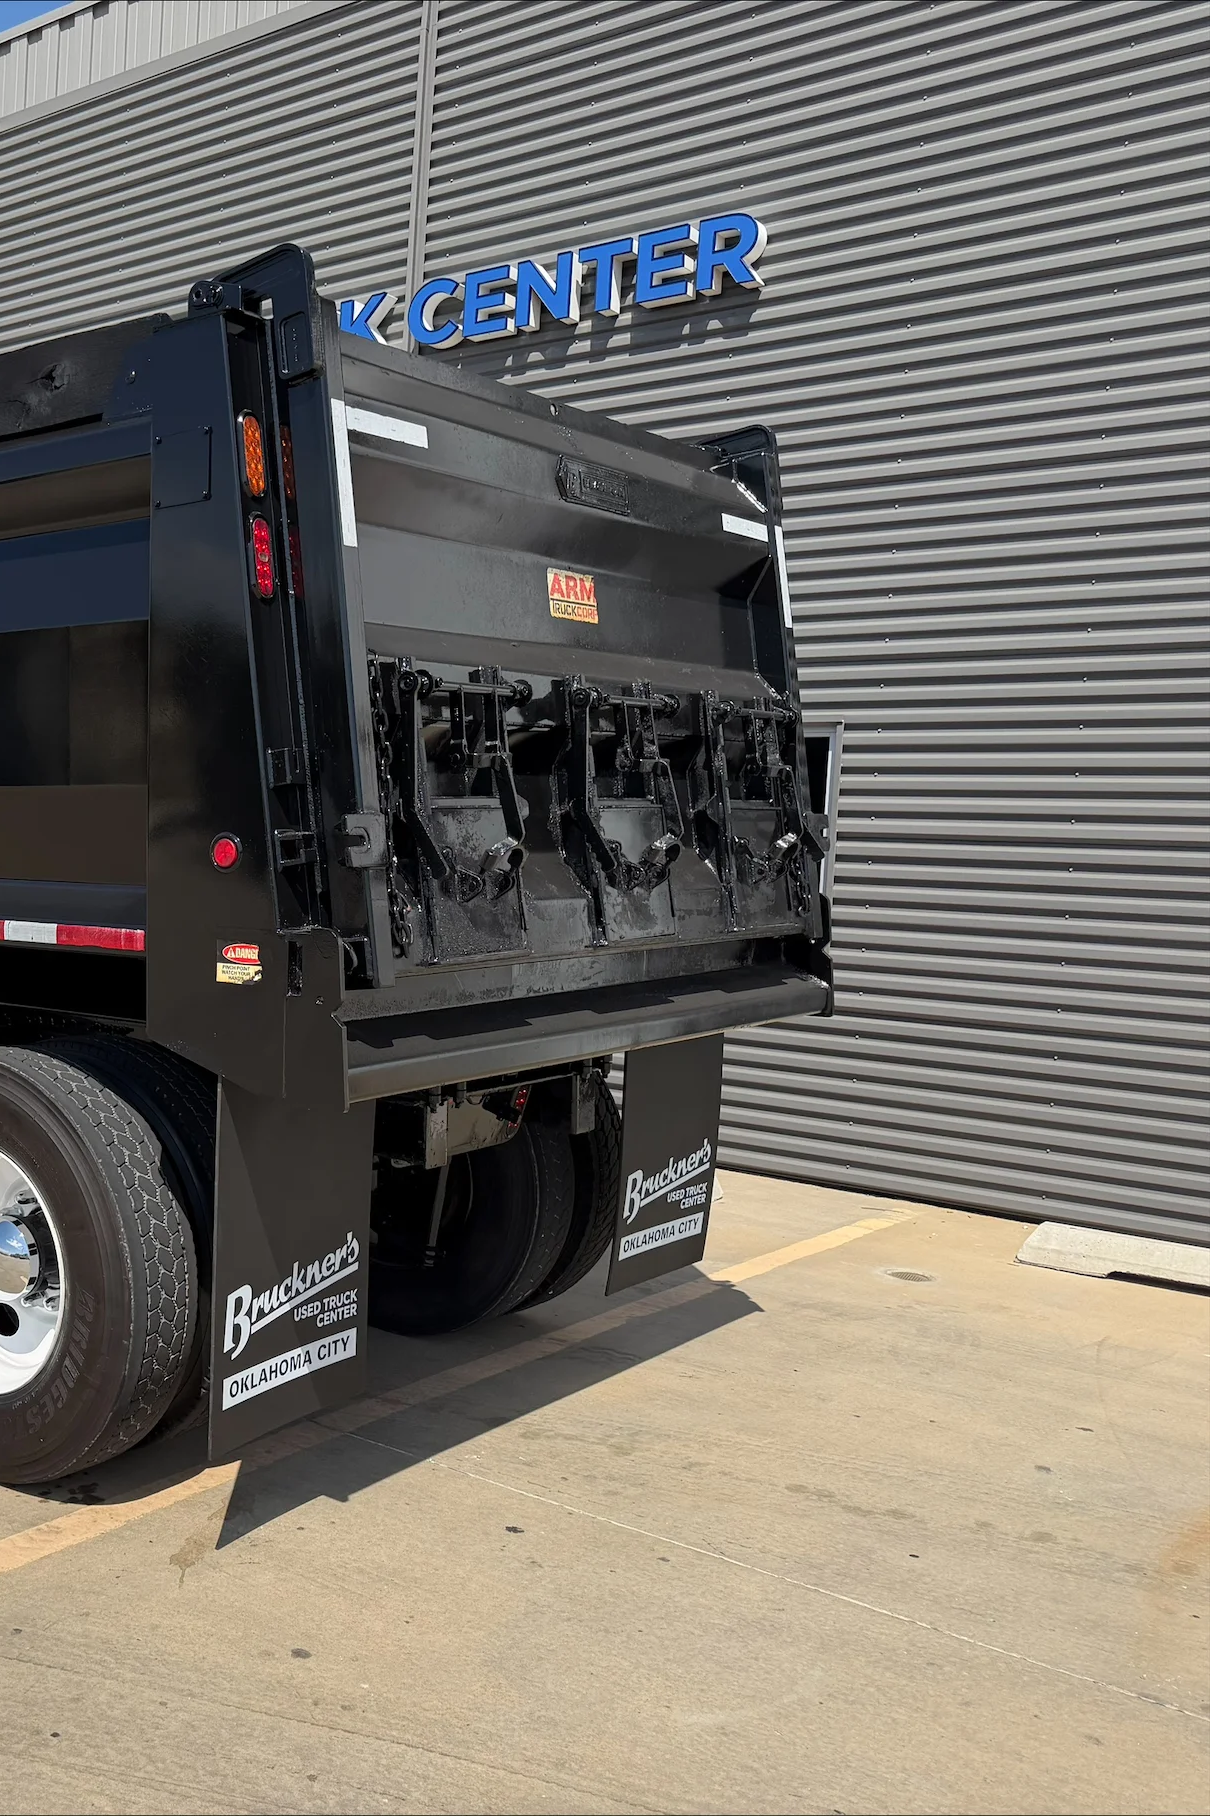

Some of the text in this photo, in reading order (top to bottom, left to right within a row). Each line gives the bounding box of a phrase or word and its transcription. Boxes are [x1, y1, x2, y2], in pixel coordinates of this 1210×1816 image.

[407, 212, 763, 347] CENTER
[550, 573, 596, 604] ARM
[235, 947, 259, 960] DANG
[623, 1137, 712, 1225] Bruckner's
[667, 1182, 708, 1203] USED TRUCK
[680, 1193, 707, 1209] CENTER
[623, 1217, 700, 1253] OKLAHOMA CITY
[223, 1231, 360, 1361] Bruckner's
[293, 1288, 358, 1322] USED TRUCK
[316, 1303, 358, 1328] CENTER
[229, 1335, 350, 1398] OKLAHOMA CITY
